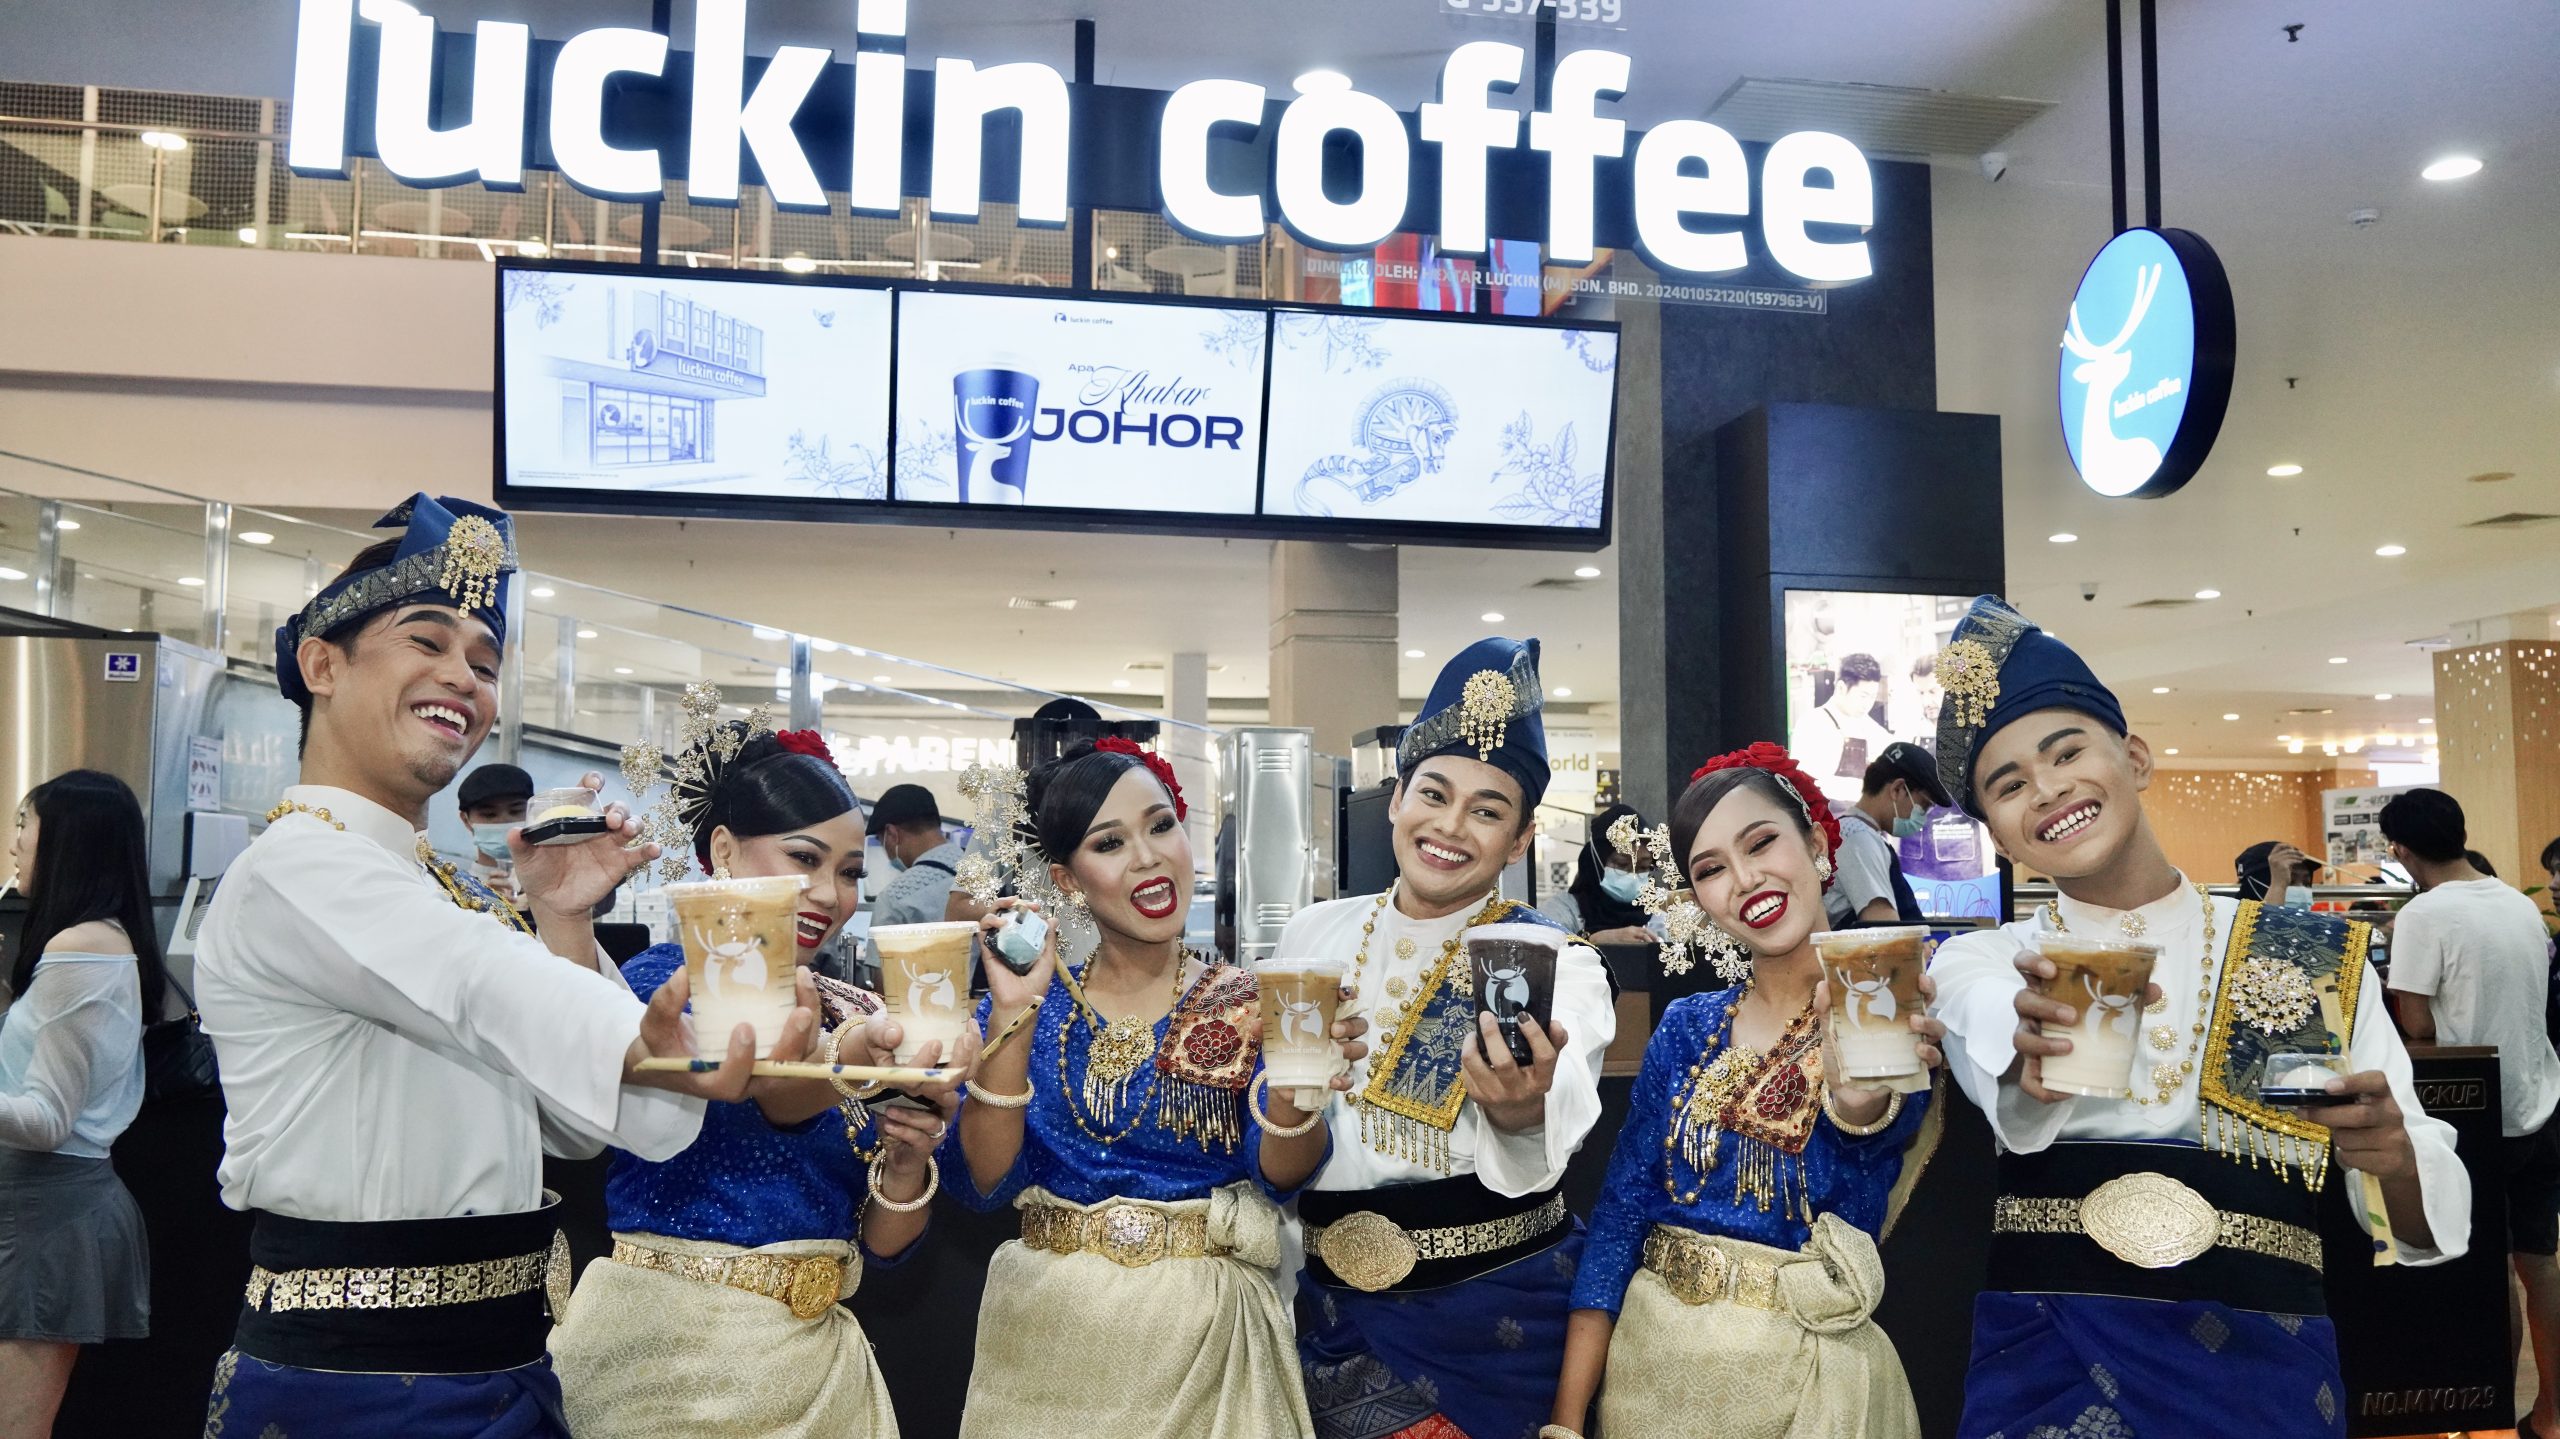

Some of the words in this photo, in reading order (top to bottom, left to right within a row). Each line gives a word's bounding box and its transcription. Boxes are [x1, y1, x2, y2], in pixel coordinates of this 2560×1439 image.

[290, 0, 1073, 221] luckin
[1161, 42, 1873, 281] coffee
[1374, 263, 1418, 280] OLEH:
[1485, 272, 1539, 288] LUCKIN
[1543, 275, 1566, 291] (M)
[1571, 279, 1604, 293] SDN.
[1608, 281, 1642, 297] BHD.
[1646, 284, 1822, 311] 202401052120(1597963-V)
[678, 358, 713, 380] luckin
[715, 370, 745, 387] coffee
[1068, 363, 1094, 373] Apa
[971, 396, 996, 406] luckin
[998, 397, 1024, 409] coffee
[1079, 366, 1211, 416] Khabar
[2114, 391, 2146, 419] luckin
[2146, 377, 2182, 405] coffee
[1031, 408, 1243, 450] JOHOR
[1549, 753, 1589, 771] orld
[2417, 1085, 2479, 1105] ICKUP
